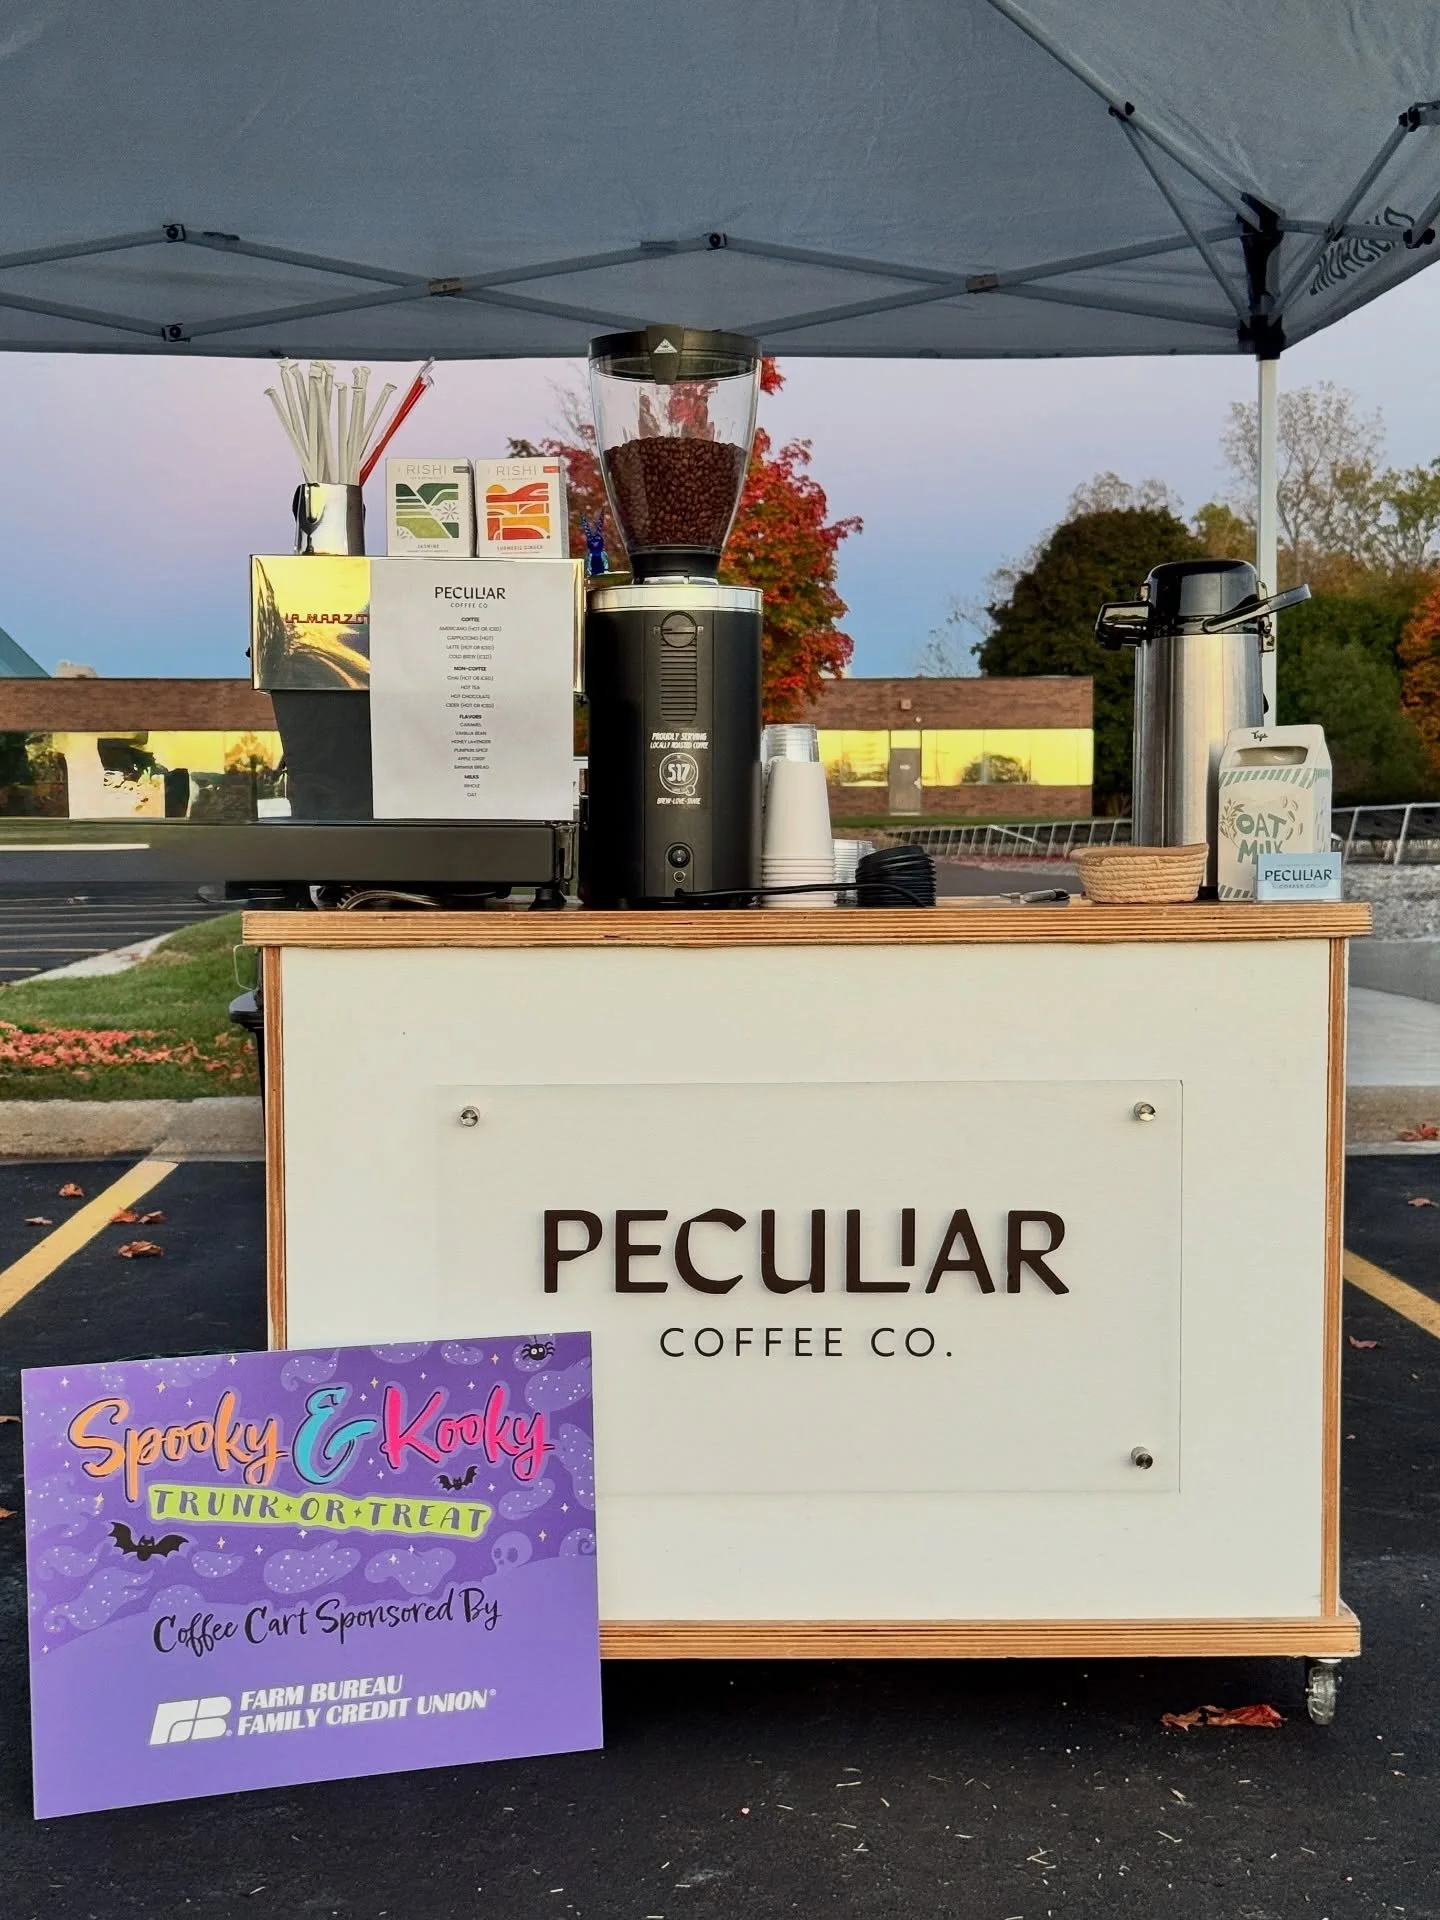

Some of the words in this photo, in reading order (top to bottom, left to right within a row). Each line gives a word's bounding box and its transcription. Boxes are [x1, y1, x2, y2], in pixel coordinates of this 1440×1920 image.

[406, 464, 447, 475] RISHI
[496, 465, 537, 476] RISHI
[434, 586, 506, 600] PECULIAR
[667, 763, 691, 782] 517
[1236, 812, 1287, 839] OAT
[1264, 868, 1332, 881] PECULIAR
[543, 1206, 1070, 1295] PECULIAR
[659, 1327, 844, 1358] COFFEE
[870, 1327, 954, 1358] CO.
[67, 1387, 291, 1504] Spooky
[291, 1385, 377, 1485] &
[382, 1384, 556, 1482] Kooky
[153, 1489, 280, 1519] TRUNK
[300, 1500, 347, 1523] OR
[369, 1501, 488, 1533] TREAT
[153, 1612, 238, 1657] Coffee
[244, 1606, 309, 1645] Cart
[315, 1587, 454, 1645] Sponsored
[458, 1587, 502, 1631] By
[239, 1684, 304, 1712] FARM
[310, 1674, 404, 1704] BUREAU
[236, 1707, 321, 1737] FAMILY
[325, 1696, 413, 1726] CREDIT
